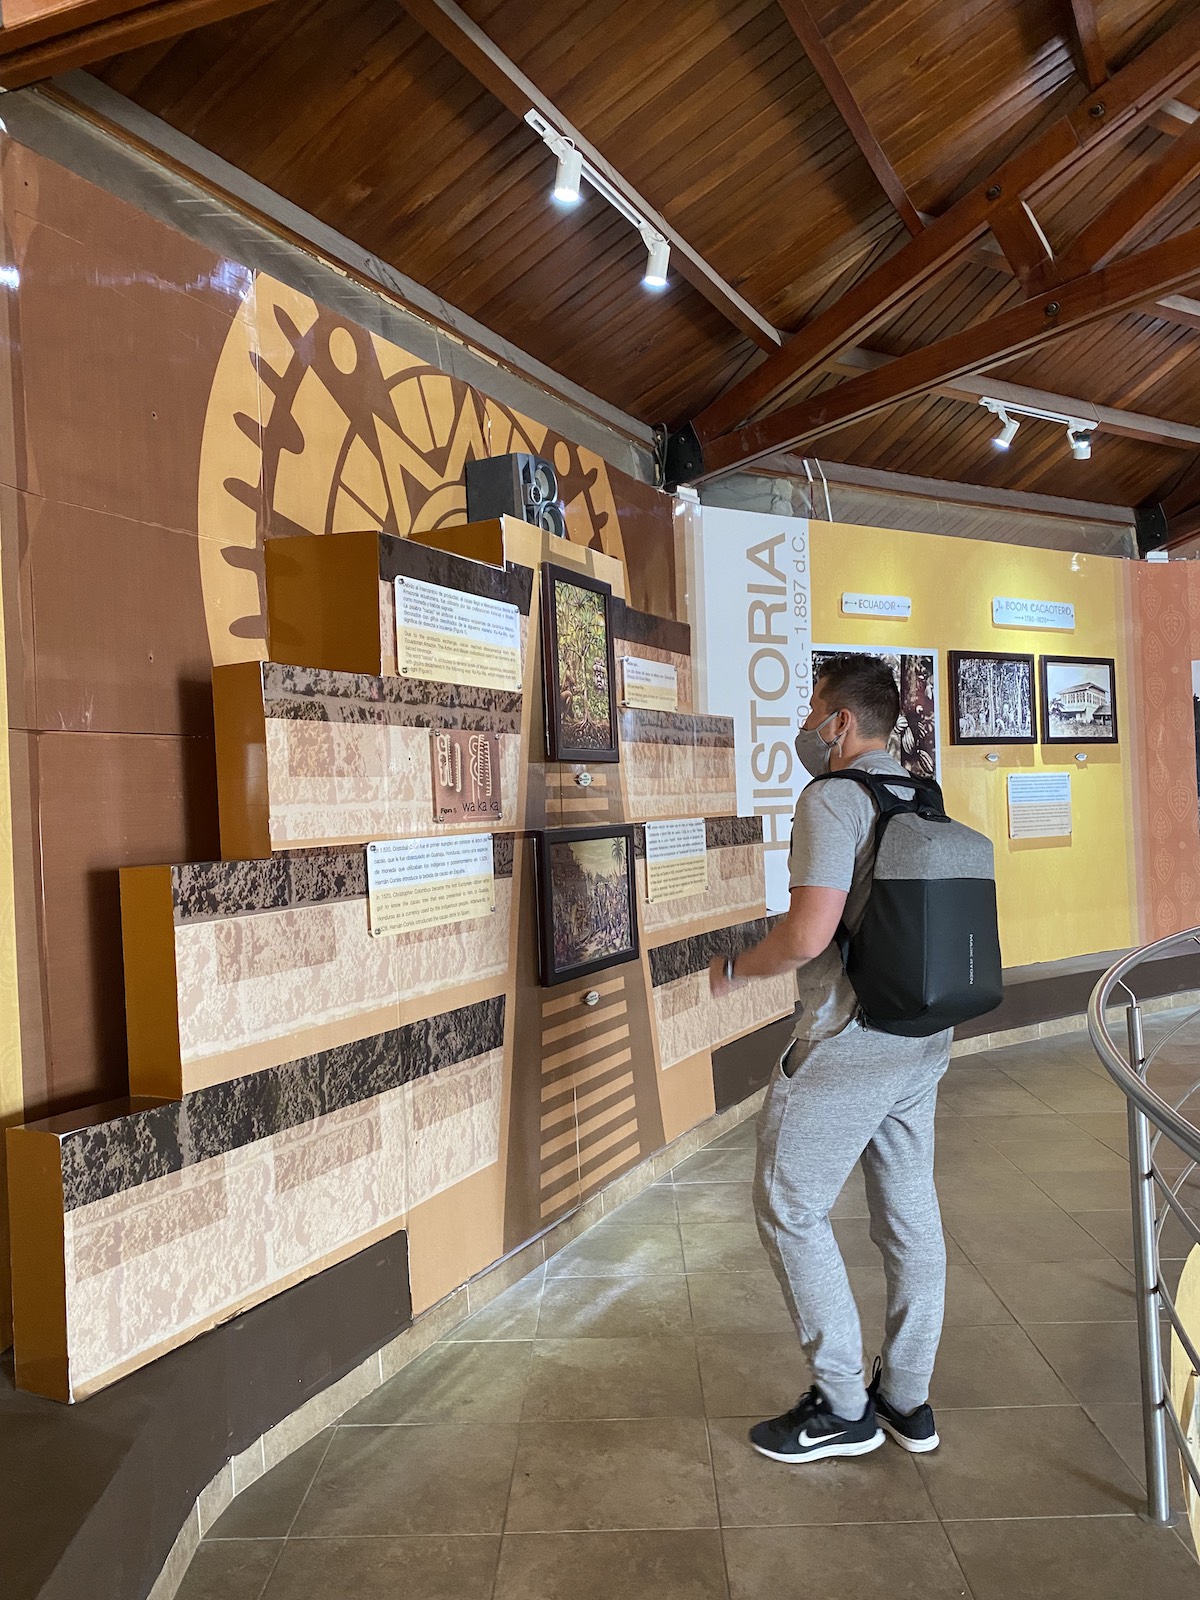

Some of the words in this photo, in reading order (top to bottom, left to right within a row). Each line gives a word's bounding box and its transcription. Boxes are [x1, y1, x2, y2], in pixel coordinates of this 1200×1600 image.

[792, 532, 806, 573] d.C.
[793, 580, 808, 635] 1.897
[858, 599, 896, 610] ECUADOR
[1006, 601, 1028, 612] BOOM
[1030, 603, 1072, 616] CACAOTERO
[746, 532, 793, 851] HISTORIA
[794, 657, 810, 699] d.C.
